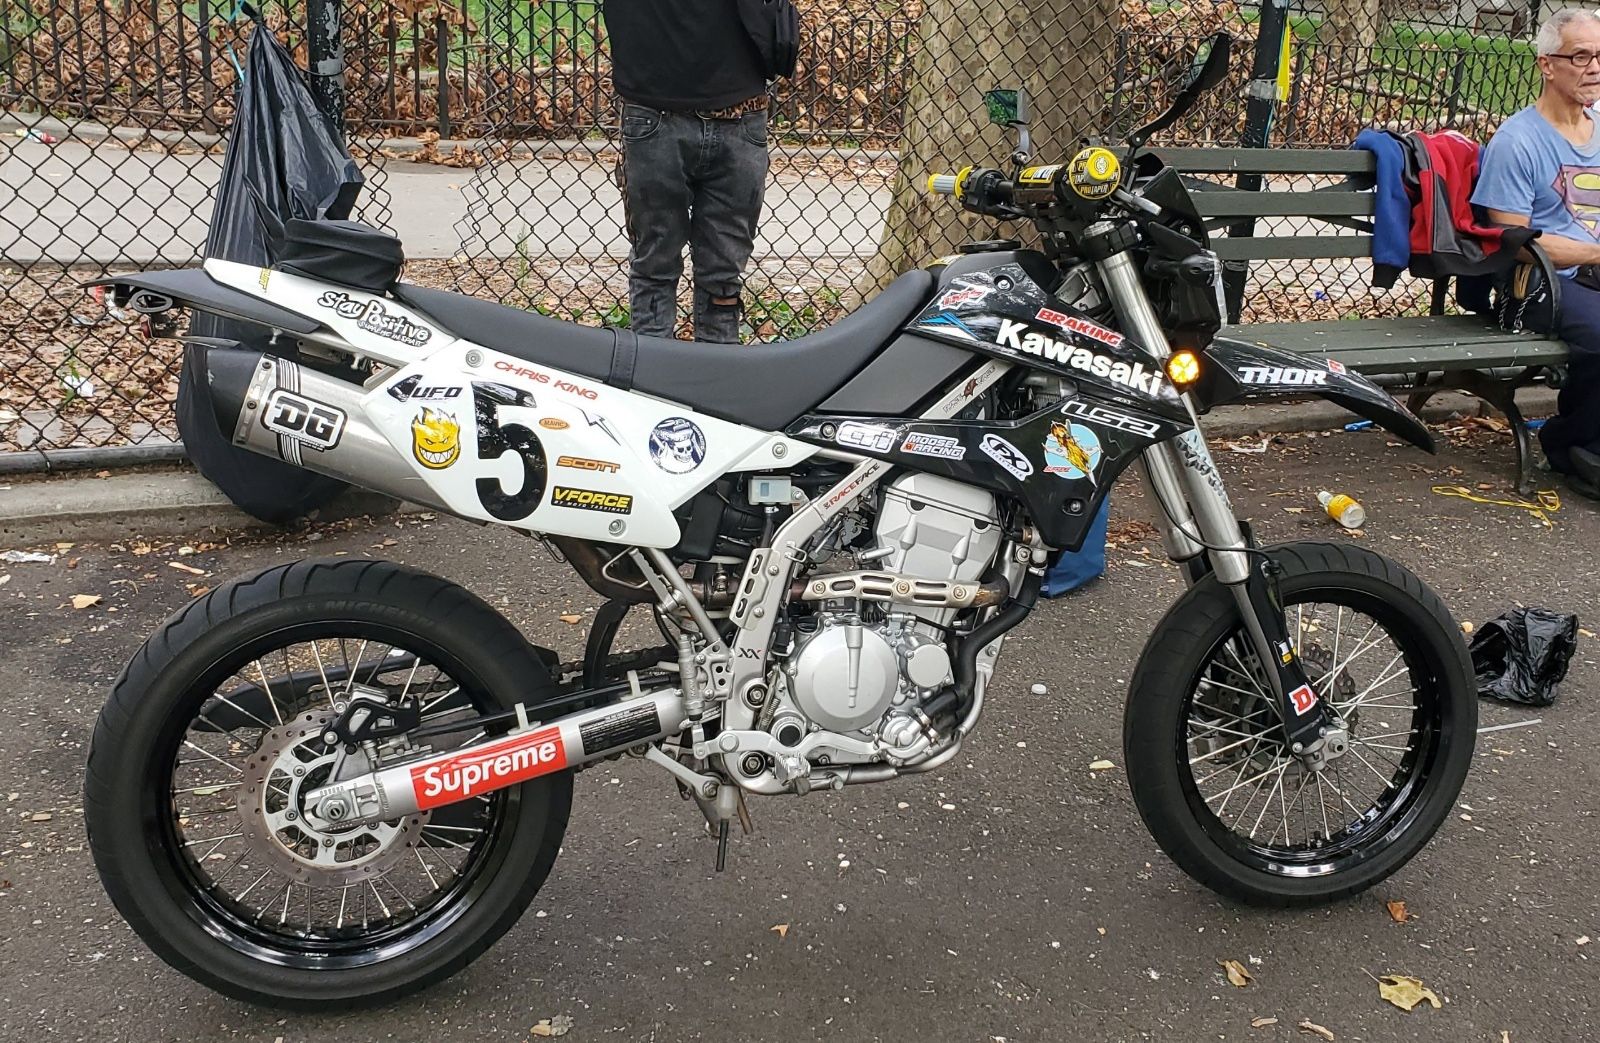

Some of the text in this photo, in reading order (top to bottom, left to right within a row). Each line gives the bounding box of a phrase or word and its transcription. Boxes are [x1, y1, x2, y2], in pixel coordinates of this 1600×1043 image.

[318, 291, 432, 341] Stay Positive
[1038, 309, 1123, 346] BRAKING
[996, 319, 1164, 396] Kawasaki
[1237, 366, 1328, 385] THOR
[411, 386, 463, 398] UFO
[494, 361, 598, 401] CHRIS KING
[271, 396, 339, 443] DG
[1060, 401, 1161, 438] LS2
[470, 380, 548, 522] 5
[909, 434, 956, 448] MOOSE
[912, 443, 962, 457] RACING
[556, 456, 621, 473] SCOTT
[555, 488, 631, 509] VFORCE
[423, 740, 557, 797] Supreme
